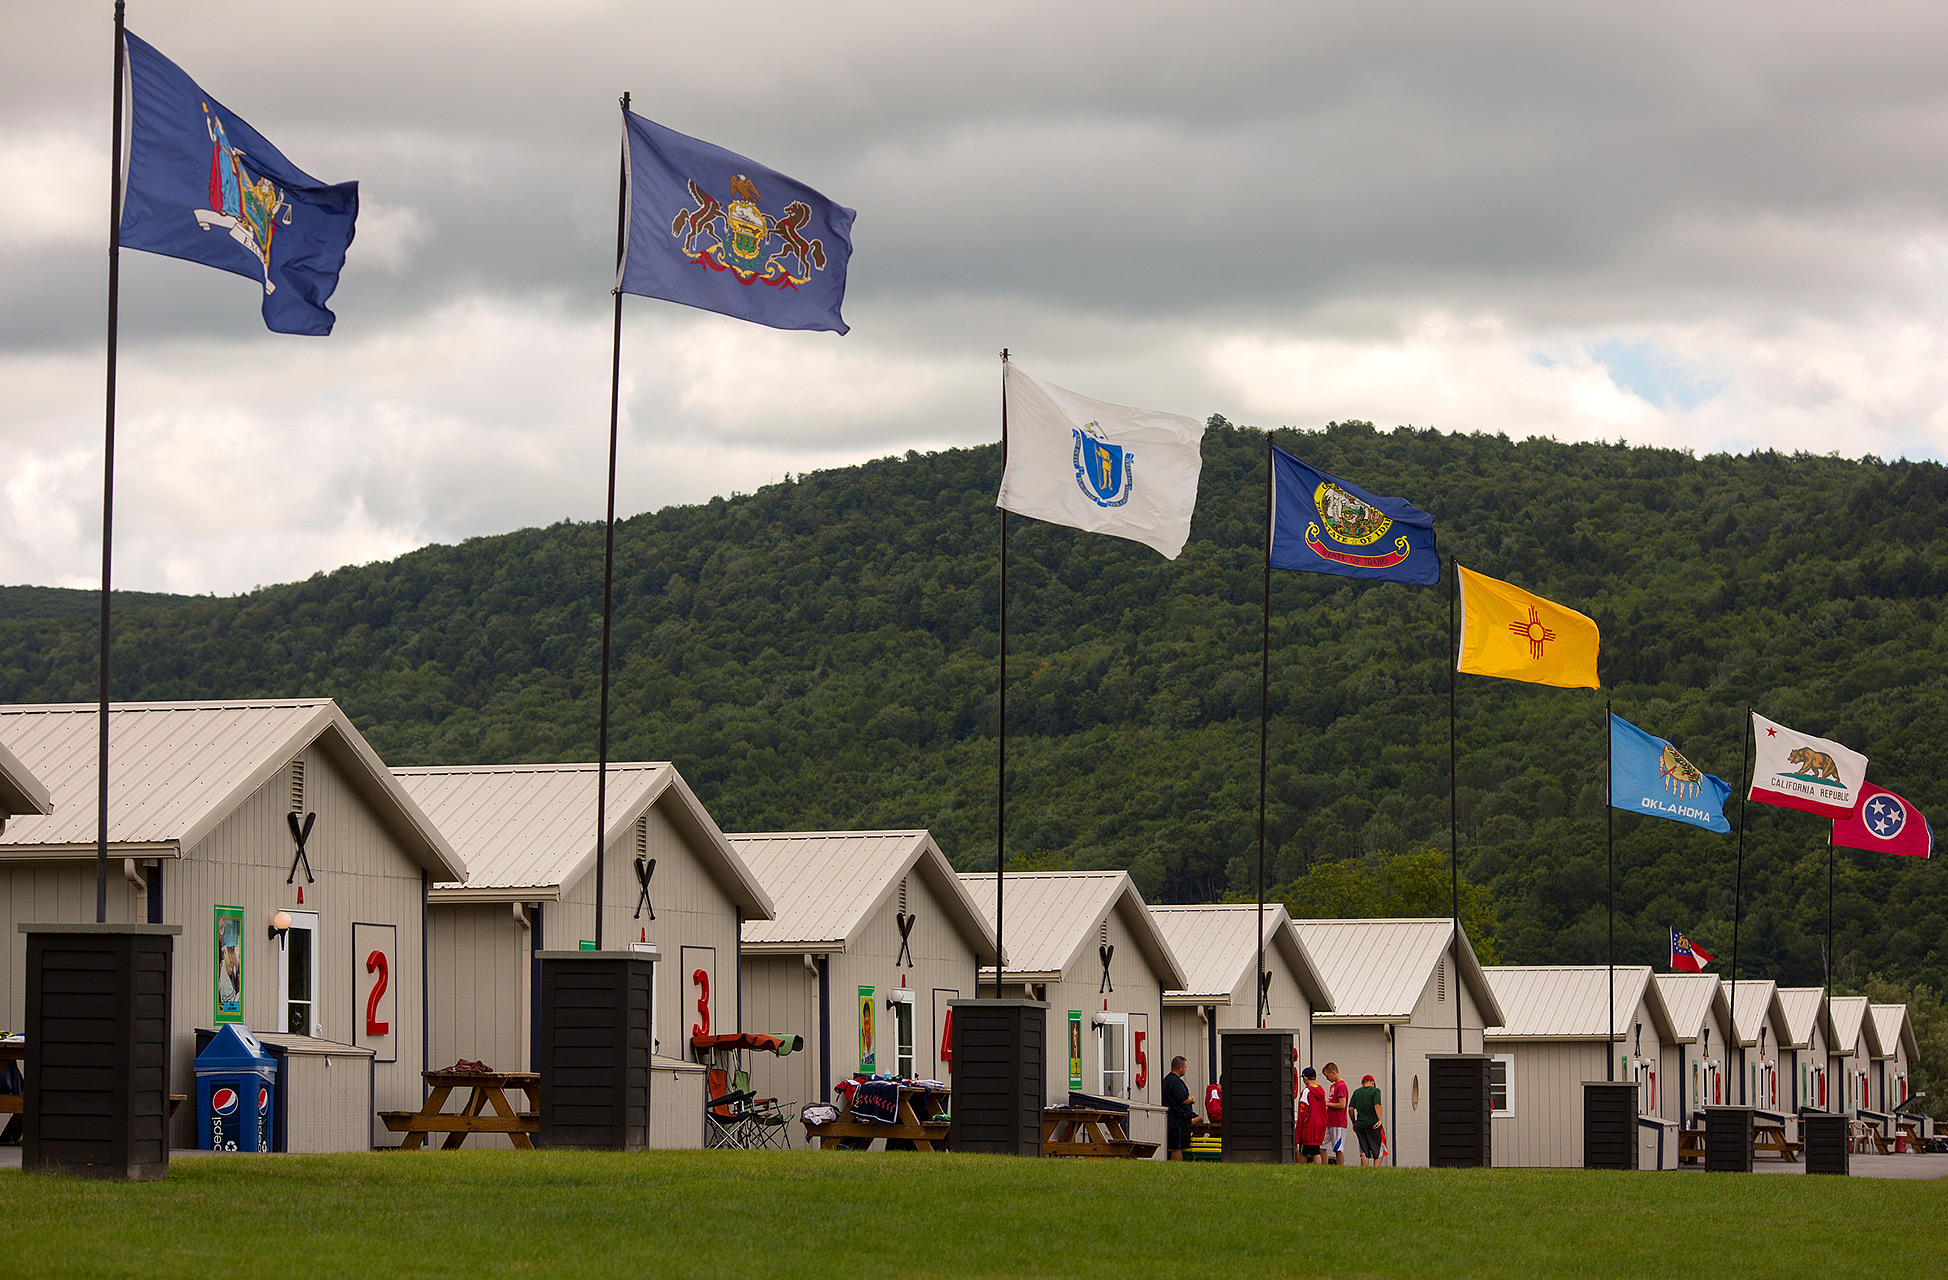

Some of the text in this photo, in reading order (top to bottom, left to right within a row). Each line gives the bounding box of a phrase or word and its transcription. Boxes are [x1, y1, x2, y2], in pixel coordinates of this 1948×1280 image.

[1324, 521, 1348, 543] STATE
[1360, 536, 1372, 545] OF
[1322, 549, 1388, 566] STATE OF IDAHO
[1771, 777, 1850, 802] CALIFORNIA REPUBLIC
[1641, 797, 1710, 823] OKLAHOMA
[366, 950, 389, 1036] 2
[692, 969, 710, 1037] 3
[1135, 1031, 1147, 1089] 5
